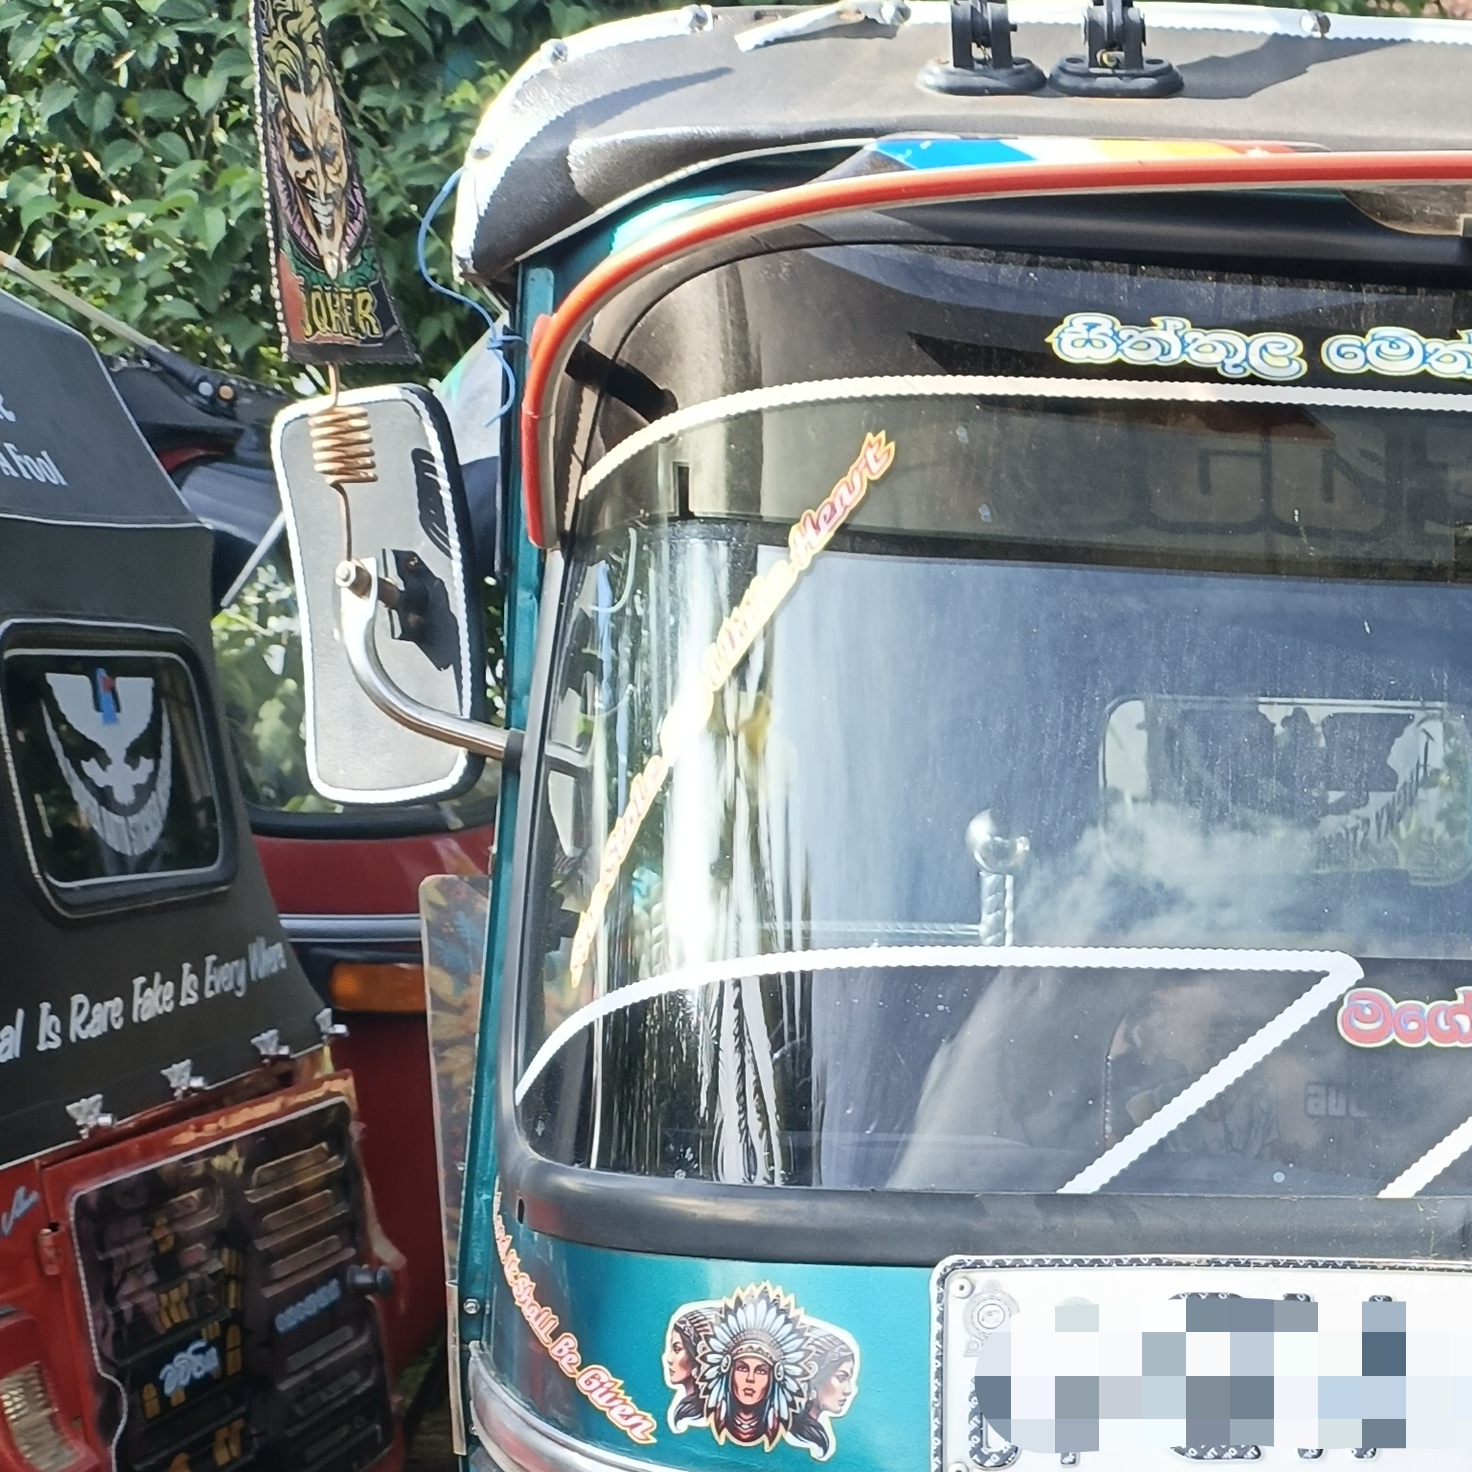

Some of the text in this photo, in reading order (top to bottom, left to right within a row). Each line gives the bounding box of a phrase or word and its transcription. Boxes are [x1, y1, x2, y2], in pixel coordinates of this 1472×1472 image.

[788, 430, 896, 570] Heart
[36, 1001, 62, 1051] Is
[69, 993, 125, 1043] Rare
[132, 971, 175, 1023] Fake
[179, 962, 199, 1007] Is
[204, 954, 247, 998] Every
[512, 1272, 560, 1348] Shall
[549, 1332, 582, 1379] Be
[575, 1364, 657, 1444] Given
